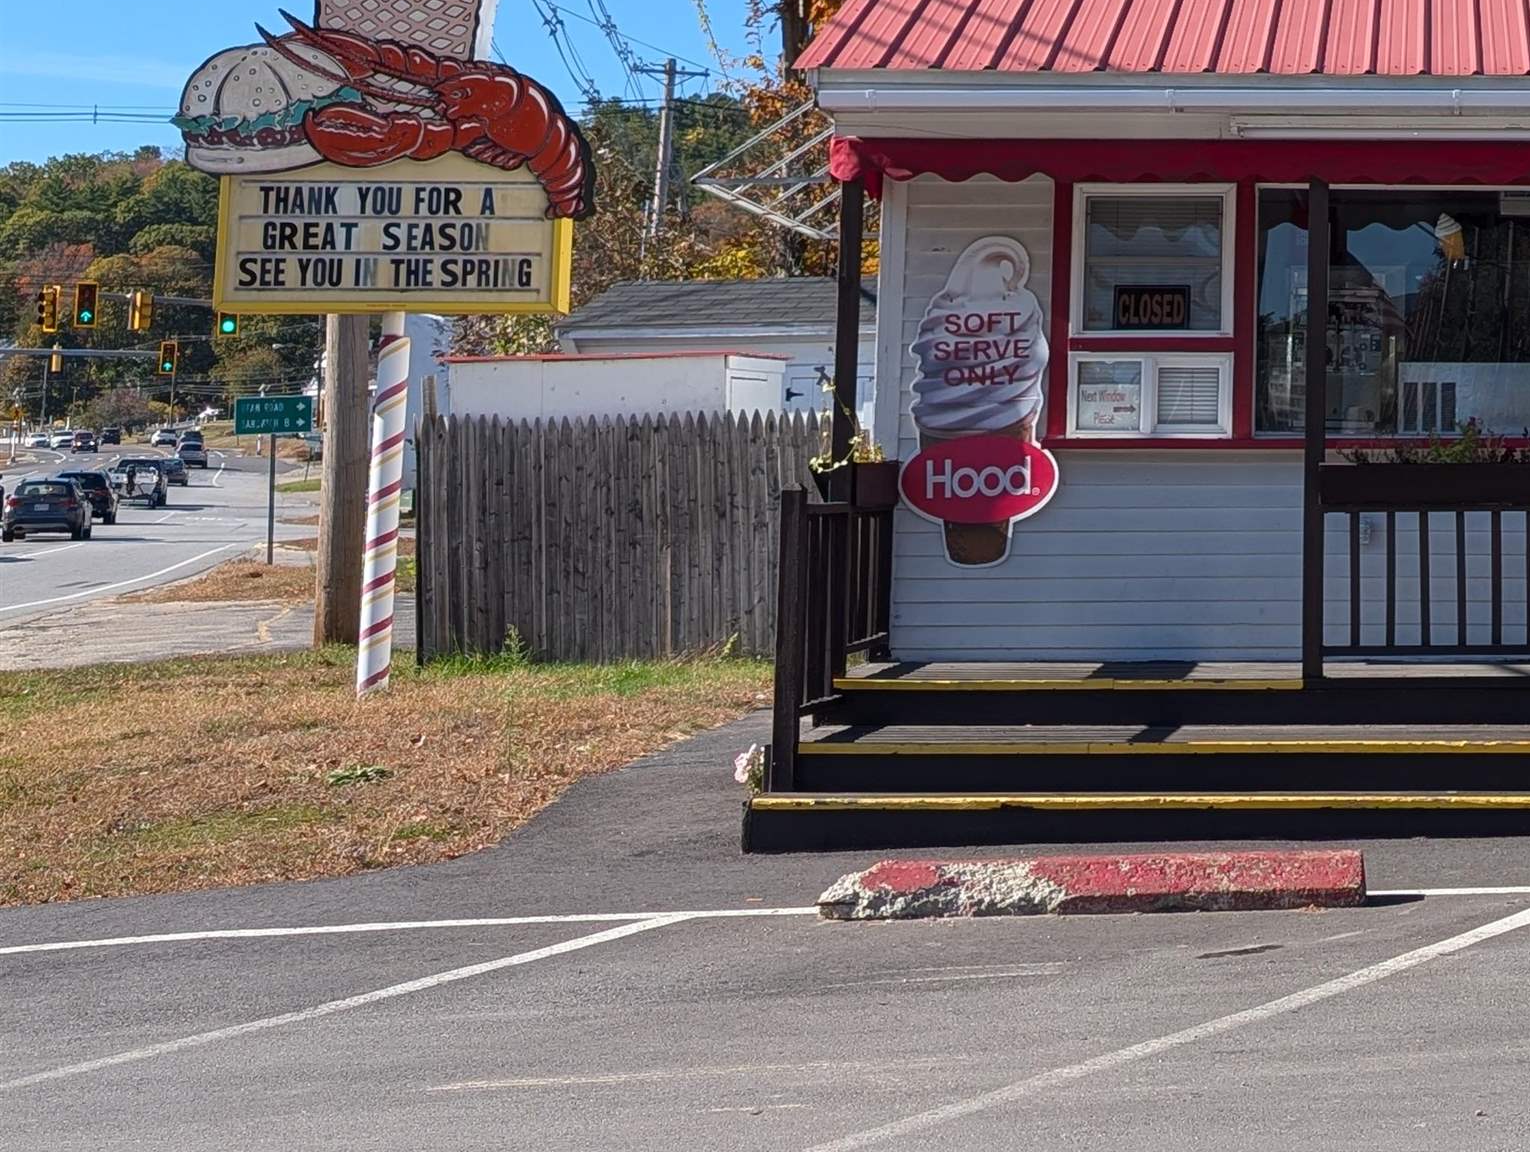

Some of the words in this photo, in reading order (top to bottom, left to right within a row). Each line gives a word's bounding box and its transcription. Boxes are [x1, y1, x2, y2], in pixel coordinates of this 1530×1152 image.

[259, 185, 338, 215] THANK
[357, 186, 402, 215] YOU
[414, 186, 463, 215] FOR
[480, 187, 495, 215] A
[262, 221, 359, 250] GREAT
[382, 222, 490, 251] SEASON
[238, 257, 286, 287] SEE
[297, 258, 343, 287] YOU
[354, 258, 378, 287] IN
[390, 258, 433, 287] THE
[440, 258, 532, 288] SPRING
[944, 311, 1021, 334] SOFT
[1119, 293, 1185, 325] CLOSED
[933, 338, 1030, 361] SERVE
[943, 364, 1020, 387] ONLY
[925, 455, 1031, 499] Hood
